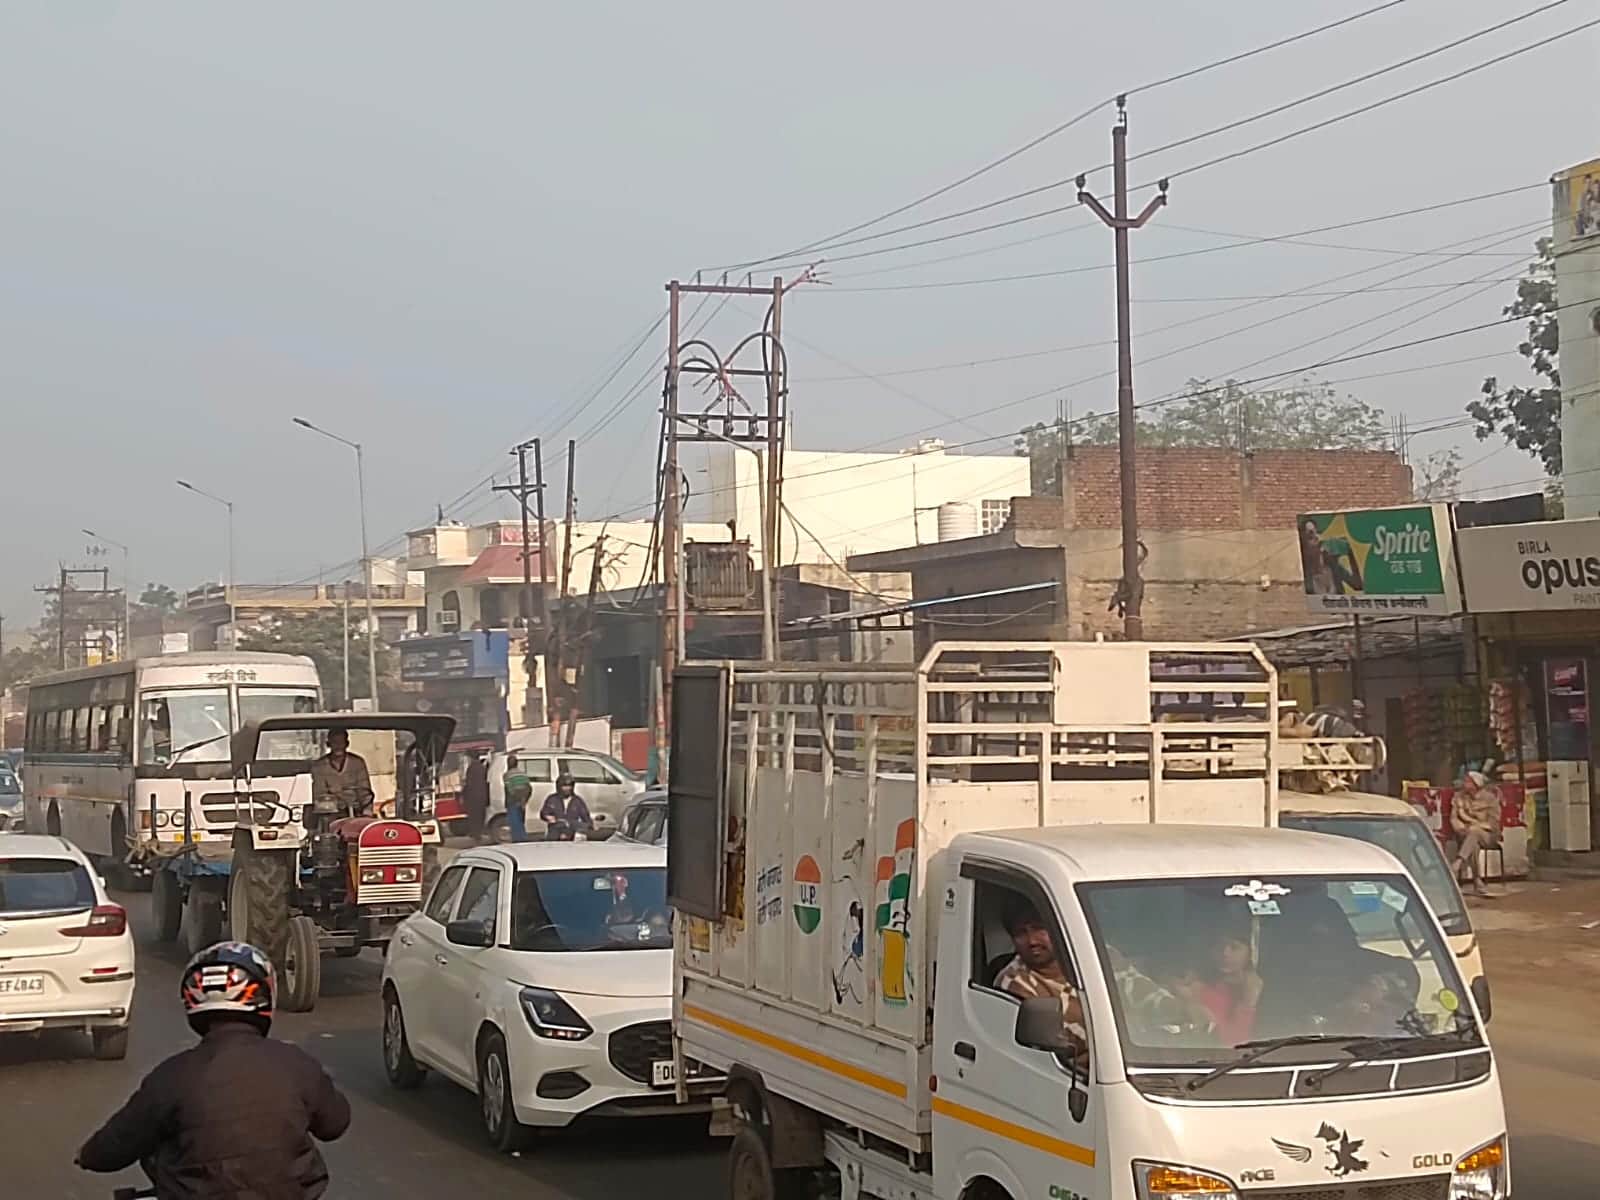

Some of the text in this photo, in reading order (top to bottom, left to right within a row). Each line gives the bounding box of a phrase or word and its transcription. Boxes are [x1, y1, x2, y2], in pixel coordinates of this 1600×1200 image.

[1374, 522, 1431, 561] Sprite
[1517, 541, 1551, 554] BIRLA
[1522, 557, 1600, 594] opus
[800, 884, 817, 905] U.P.
[1413, 1153, 1453, 1168] GOLD
[1240, 1169, 1275, 1183] ACE
